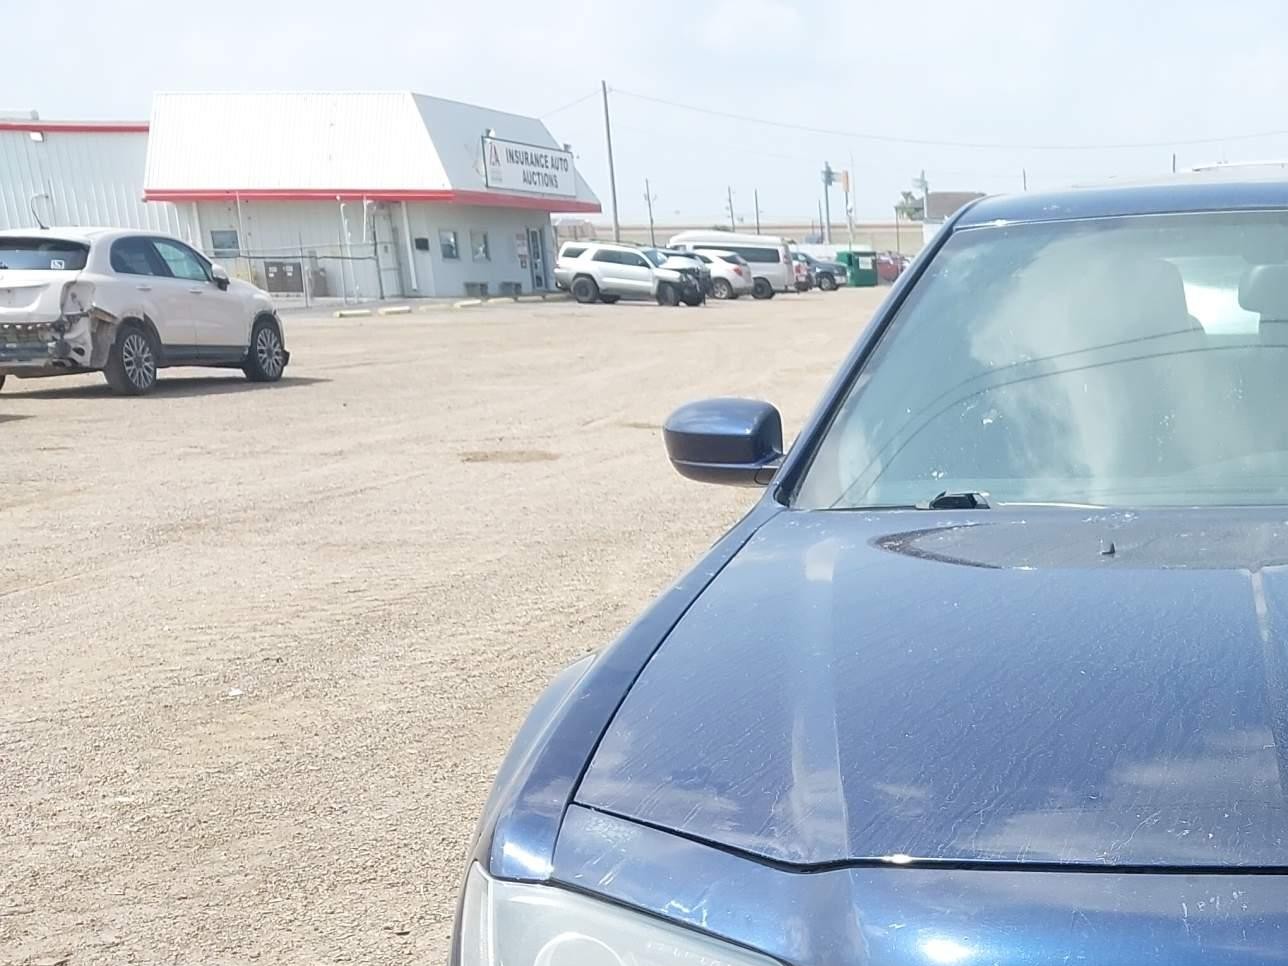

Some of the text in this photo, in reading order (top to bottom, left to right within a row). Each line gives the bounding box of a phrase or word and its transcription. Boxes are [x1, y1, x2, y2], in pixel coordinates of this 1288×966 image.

[505, 147, 569, 173] INSURANCE AUTO
[522, 170, 559, 189] AUCTIONS
